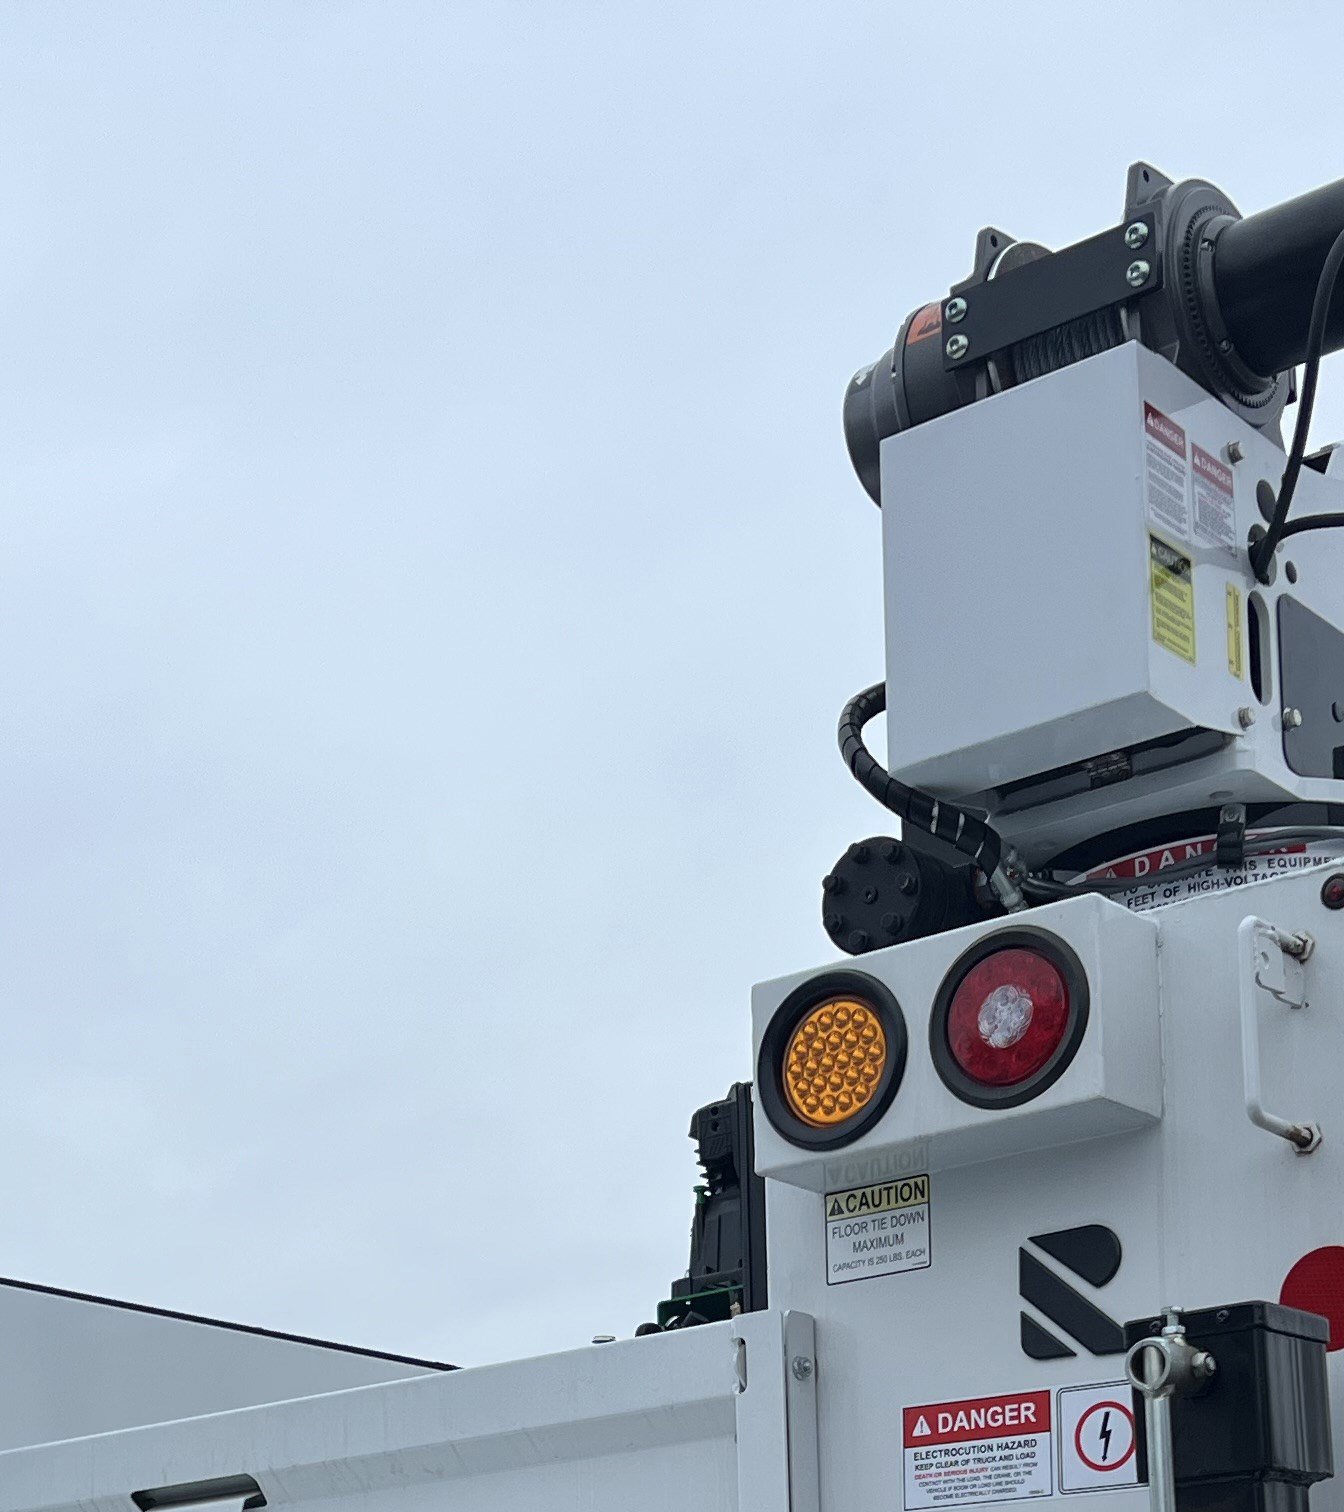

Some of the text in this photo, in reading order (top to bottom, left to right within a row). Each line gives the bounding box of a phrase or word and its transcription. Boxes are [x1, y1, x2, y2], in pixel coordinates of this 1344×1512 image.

[1127, 890, 1157, 909] FEET
[1163, 886, 1180, 899] OF
[845, 1179, 925, 1213] CAUTION
[832, 1210, 925, 1239] FLOOR TIE DOWN
[852, 1232, 904, 1254] MAXIMUM
[832, 1259, 866, 1274] CAPACITY
[906, 1248, 926, 1260] EACH
[937, 1402, 1037, 1434] DANGER
[913, 1438, 1037, 1462] ELECTROCUTION HAZARD
[914, 1451, 1036, 1471] KEEP CLEAR OF TRUCK AND LOAD
